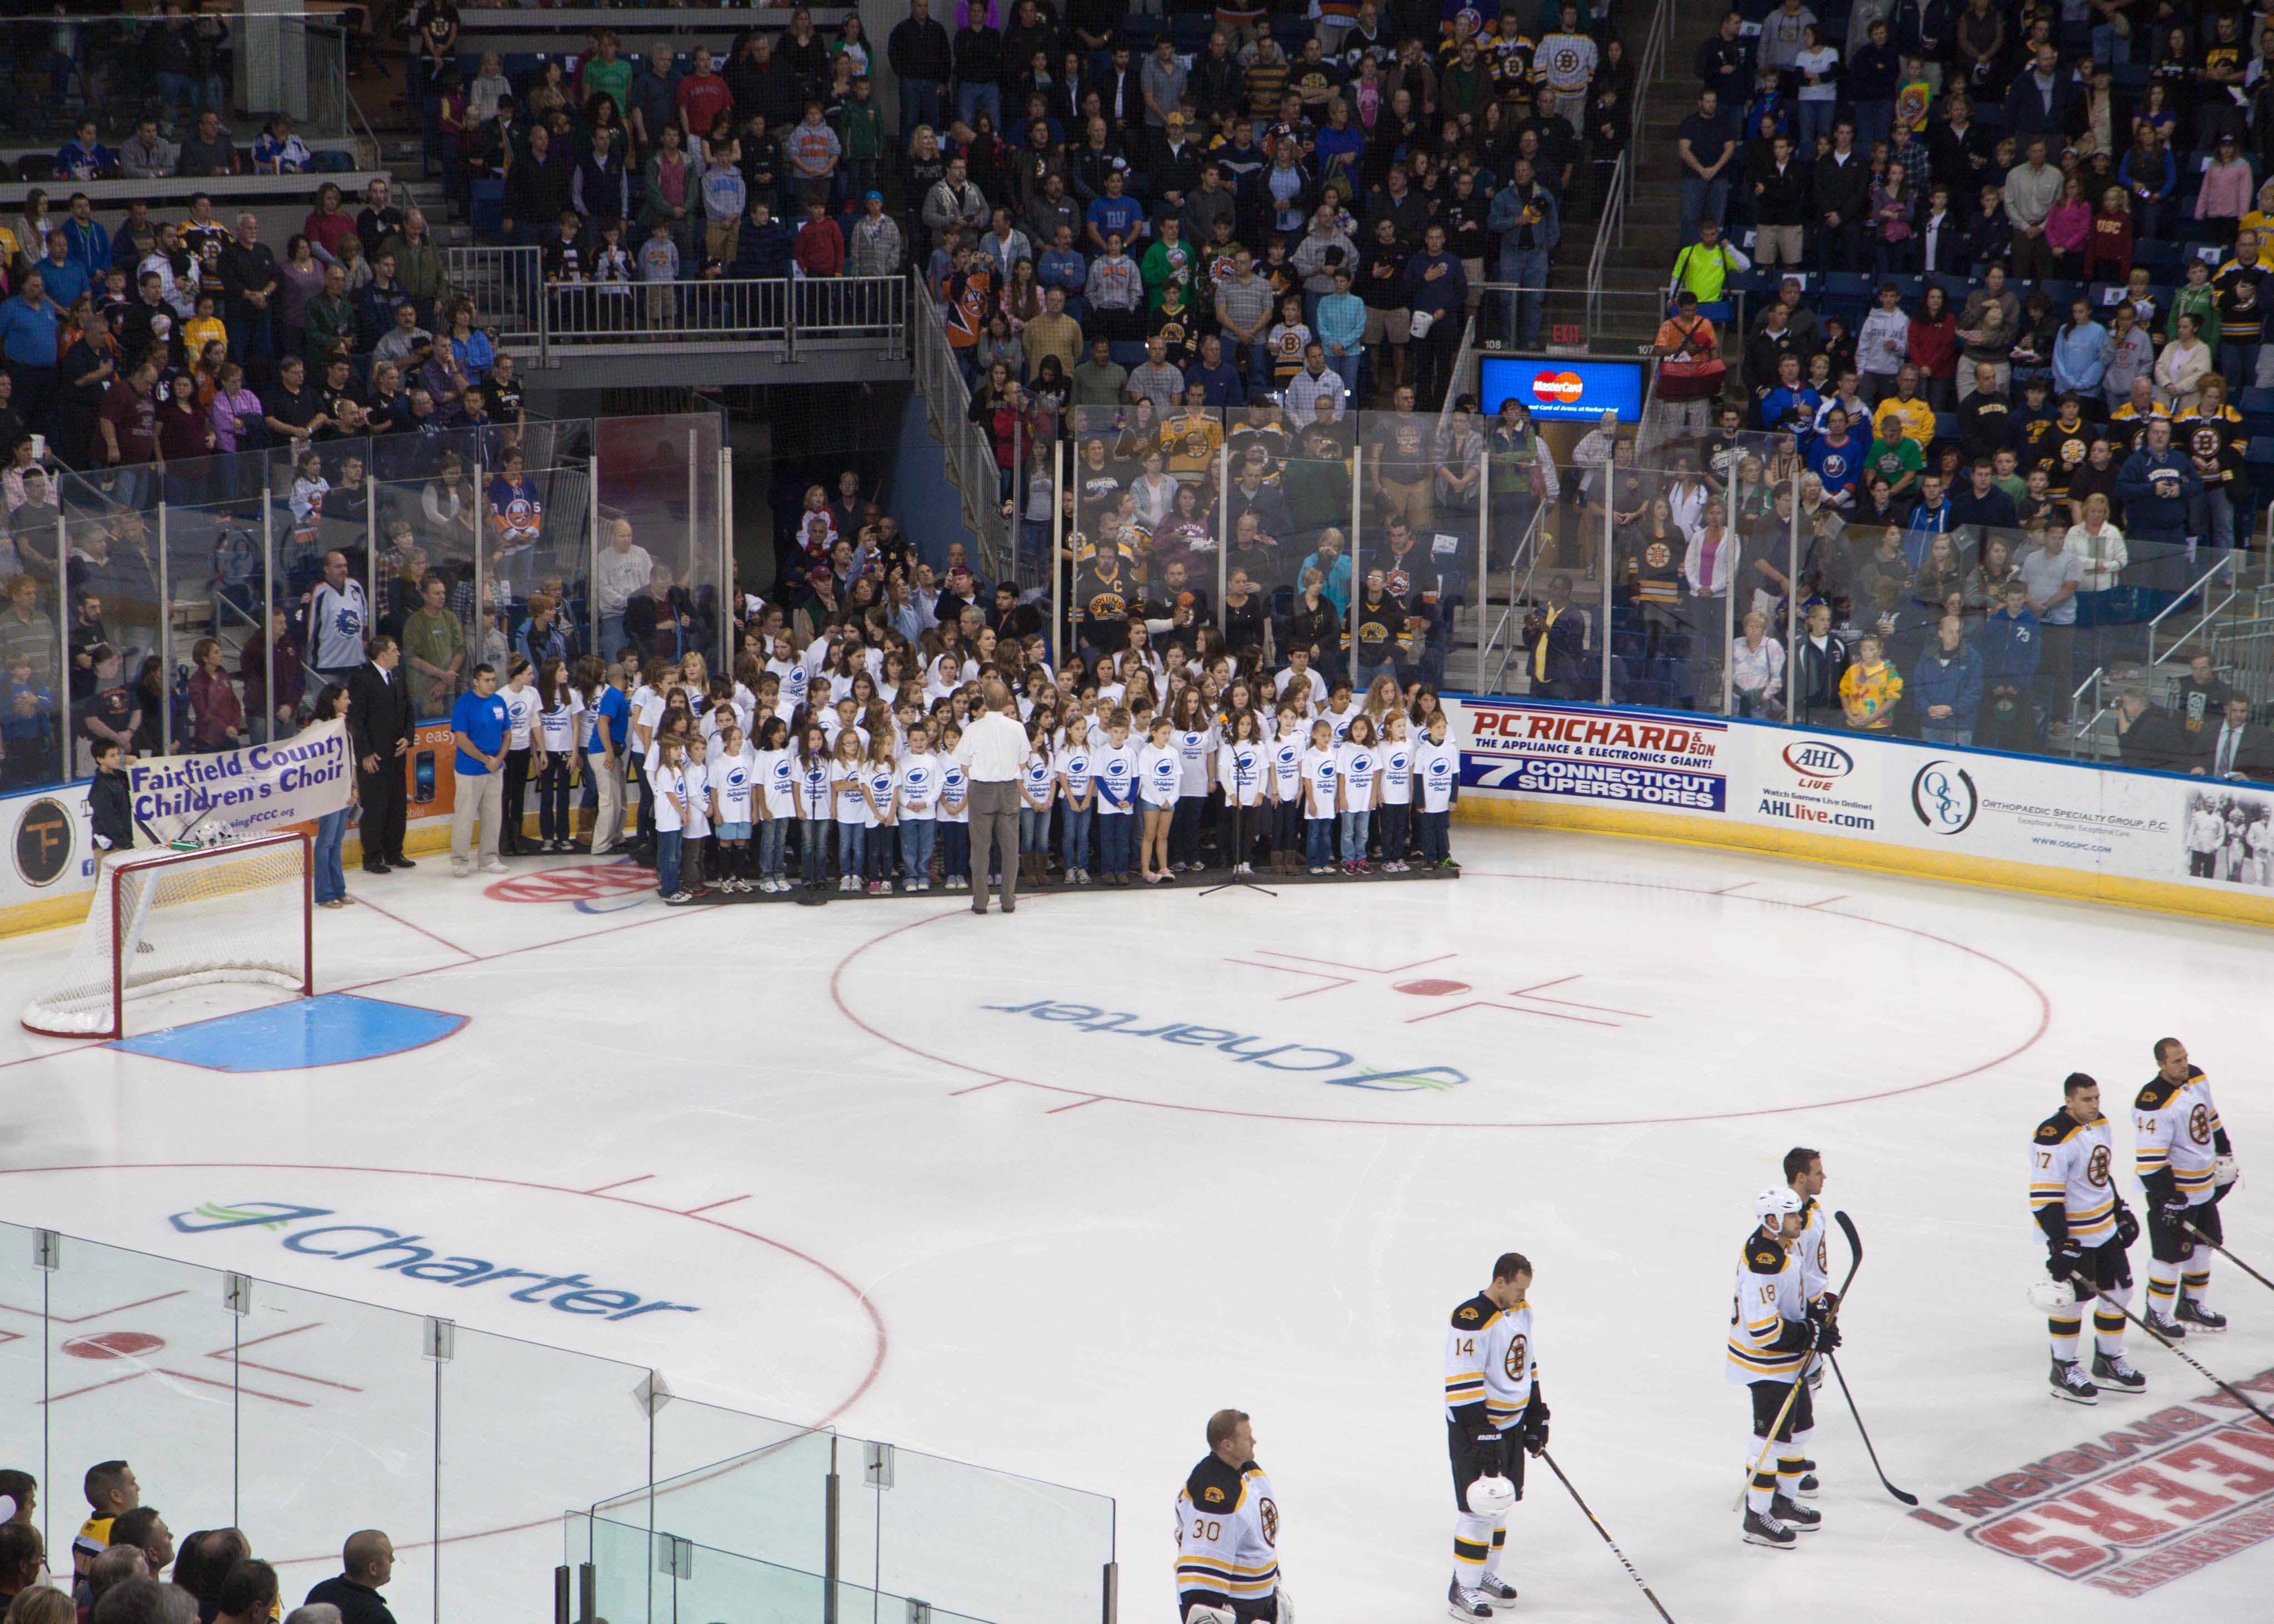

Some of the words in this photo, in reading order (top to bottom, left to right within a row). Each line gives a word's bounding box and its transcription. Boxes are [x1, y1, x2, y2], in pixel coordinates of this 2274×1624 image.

[2096, 220, 2122, 234] USC
[1552, 324, 1580, 343] EXIT
[1485, 340, 1501, 350] 108
[1638, 345, 1654, 355] 107
[1532, 381, 1584, 393] MasterCard
[1114, 580, 1123, 592] C
[1091, 595, 1124, 611] BRUINS
[1360, 624, 1387, 637] BRUINS
[2016, 626, 2031, 643] 73
[426, 729, 455, 745] easy
[1471, 712, 1521, 738] P.C.
[1527, 716, 1690, 754] RICHARD
[1692, 731, 1703, 742] &
[1475, 738, 1497, 749] THE
[1501, 740, 1570, 754] APPLIANCE
[1574, 746, 1584, 755] &
[1589, 747, 1666, 764] ELECTRONICS
[1671, 756, 1713, 769] GIANT!
[1688, 743, 1716, 756] SON
[1795, 749, 1840, 770] AHL
[131, 752, 243, 793] Fairfield
[250, 734, 343, 770] County
[1470, 756, 1524, 787] 7
[280, 760, 344, 792] Choir
[1526, 761, 1715, 792] CONNECTICUT
[1798, 778, 1834, 791] LIVE
[1518, 775, 1714, 808] SUPERSTORES
[1763, 788, 1790, 798] Watch
[1791, 793, 1821, 803] Games
[1823, 797, 1840, 805] Live
[1842, 800, 1872, 811] Online!
[1923, 771, 1963, 825] OSG
[1758, 799, 1875, 830] AHLlive.com
[1982, 799, 2051, 816] ORTHOPAEDIC
[2053, 808, 2107, 823] SPECIALTY
[2149, 820, 2170, 831] P.C.
[981, 999, 1355, 1072] Charter
[2036, 1152, 2053, 1169] 17
[282, 1225, 701, 1323] Charter
[1759, 1284, 1776, 1304] 18
[1455, 1337, 1475, 1357] 14
[1192, 1518, 1222, 1542] 30
